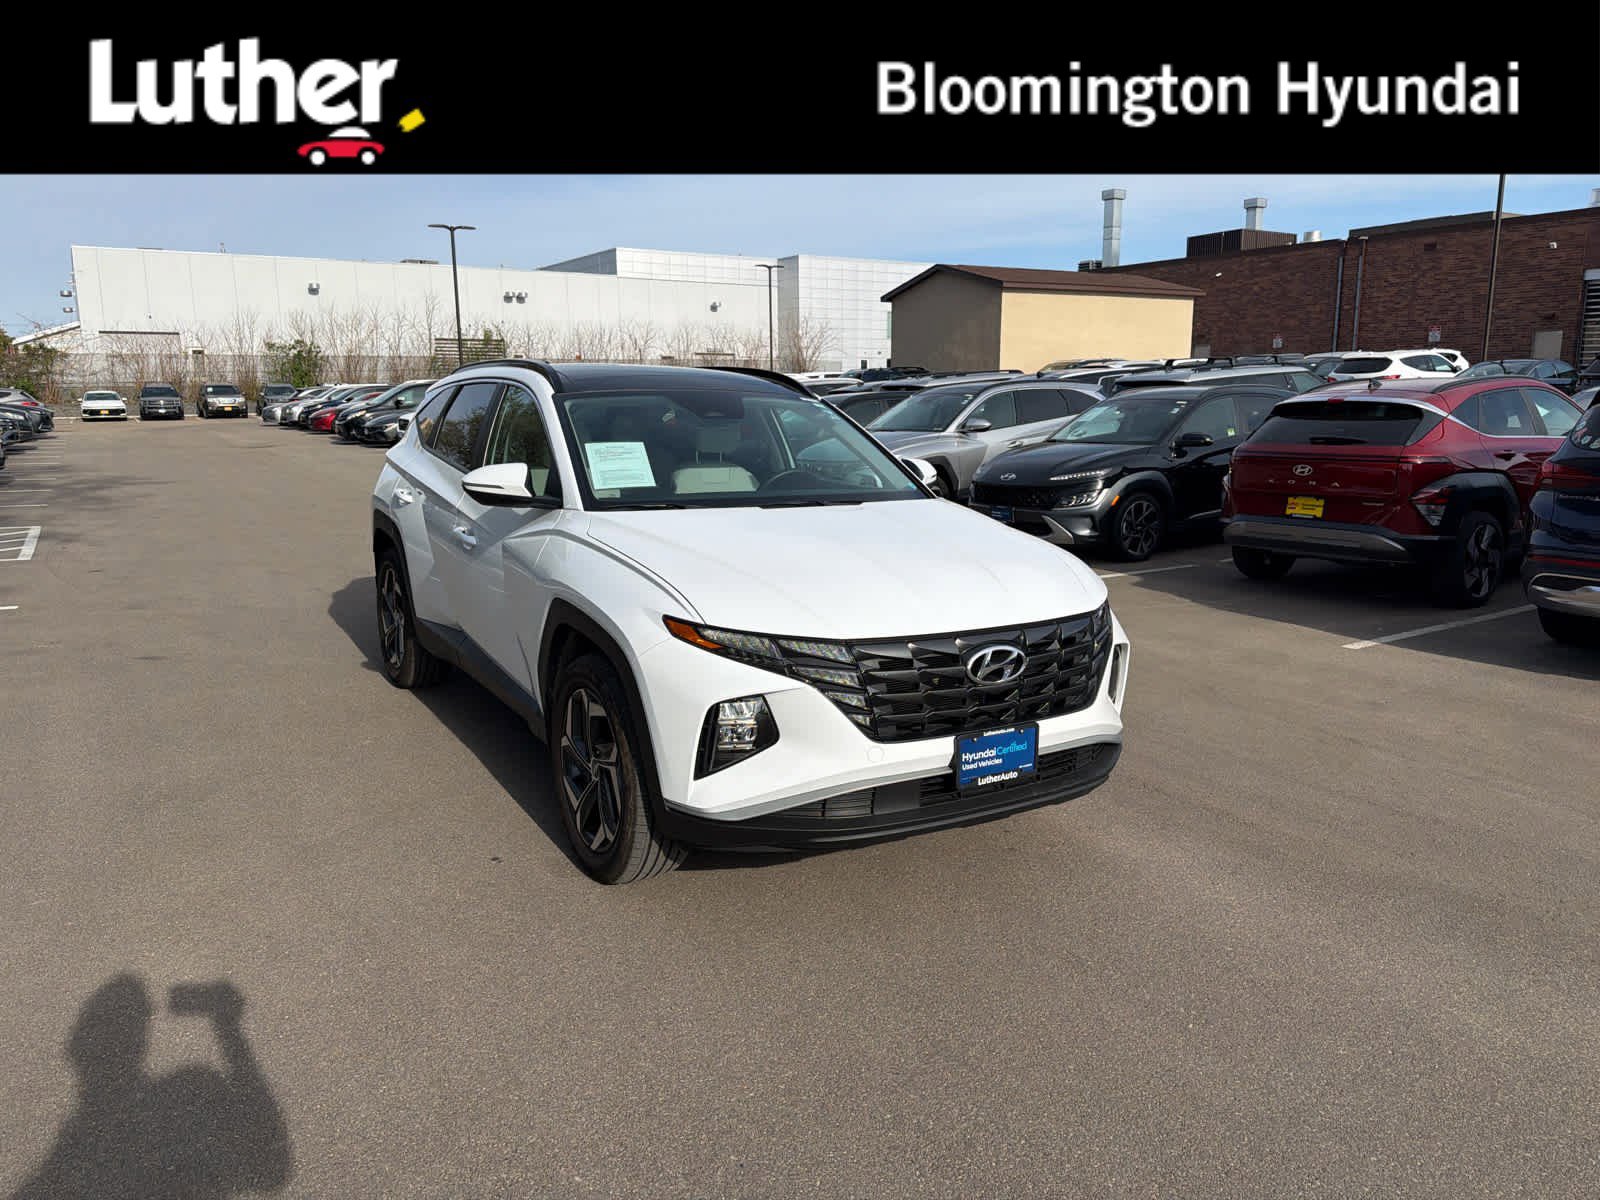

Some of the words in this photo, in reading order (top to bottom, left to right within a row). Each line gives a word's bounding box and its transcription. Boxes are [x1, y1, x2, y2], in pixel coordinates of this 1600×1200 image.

[962, 762, 978, 771] Used
[978, 758, 1003, 767] Vehicles
[978, 771, 1018, 785] LutherAuto
